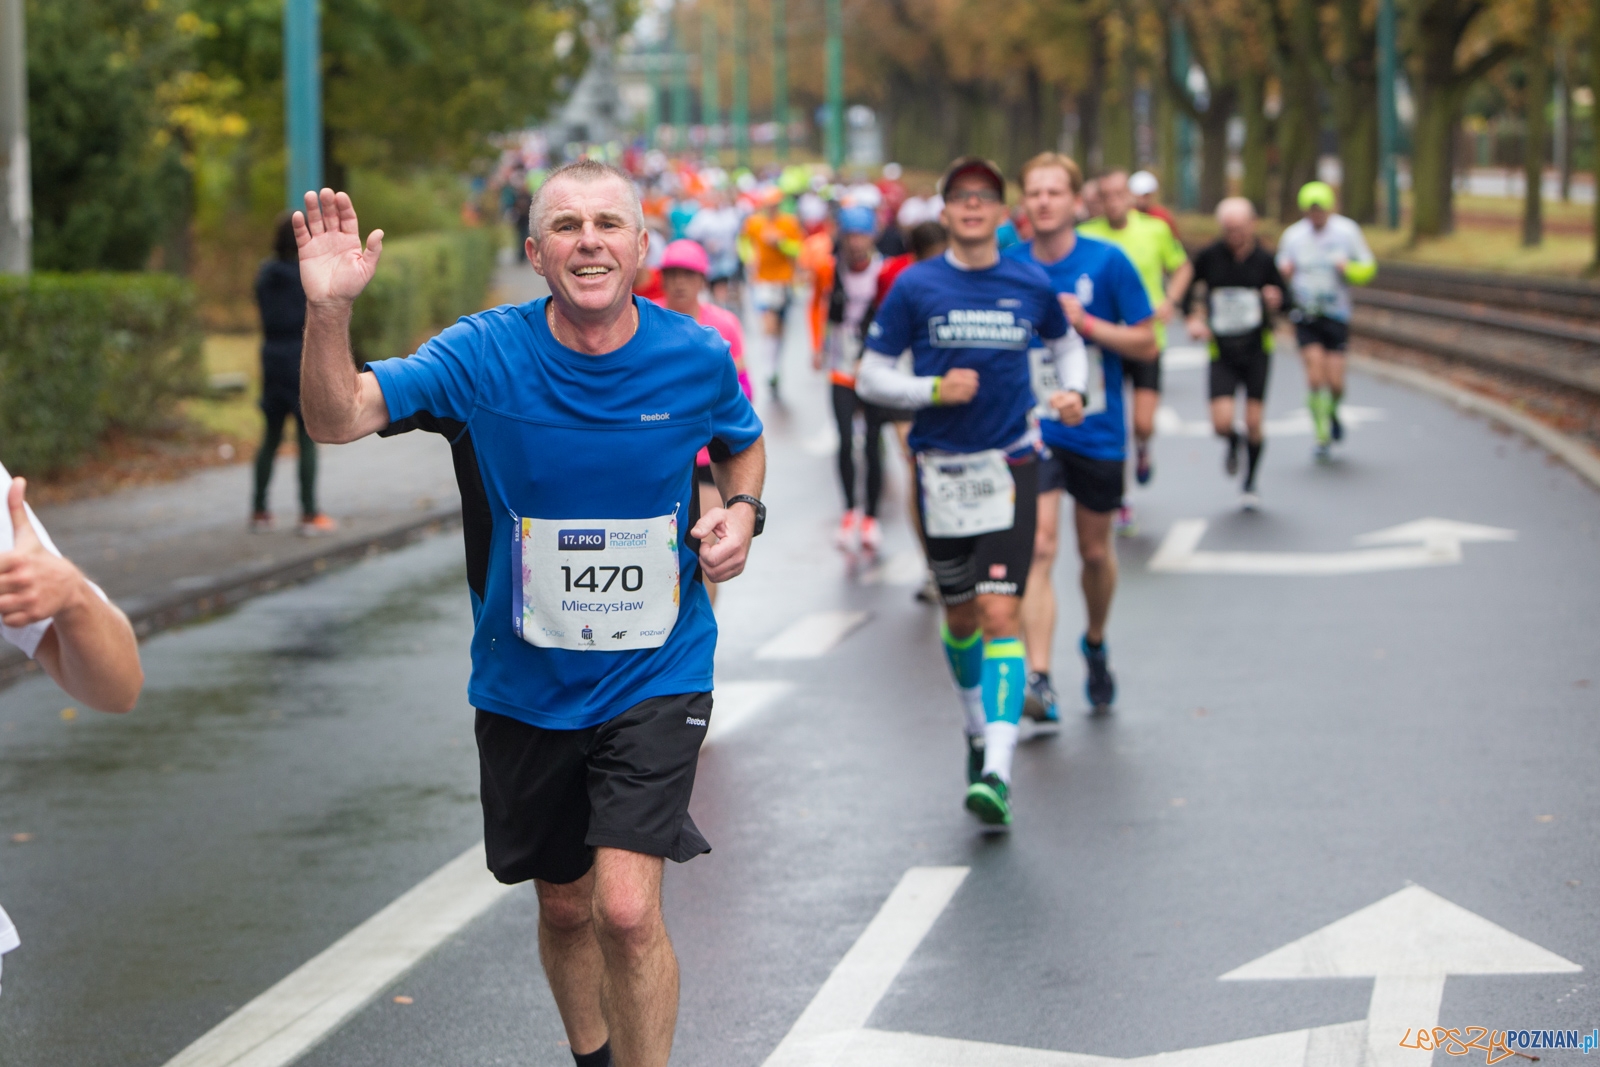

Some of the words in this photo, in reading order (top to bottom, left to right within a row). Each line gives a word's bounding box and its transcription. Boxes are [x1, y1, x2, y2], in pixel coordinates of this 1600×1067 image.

[641, 412, 670, 422] Reebok
[562, 535, 577, 545] 17.
[579, 534, 602, 545] PKO
[610, 539, 647, 547] maraton
[560, 565, 644, 593] 1470
[561, 600, 644, 614] Mieczysław
[686, 716, 706, 726] Reebok
